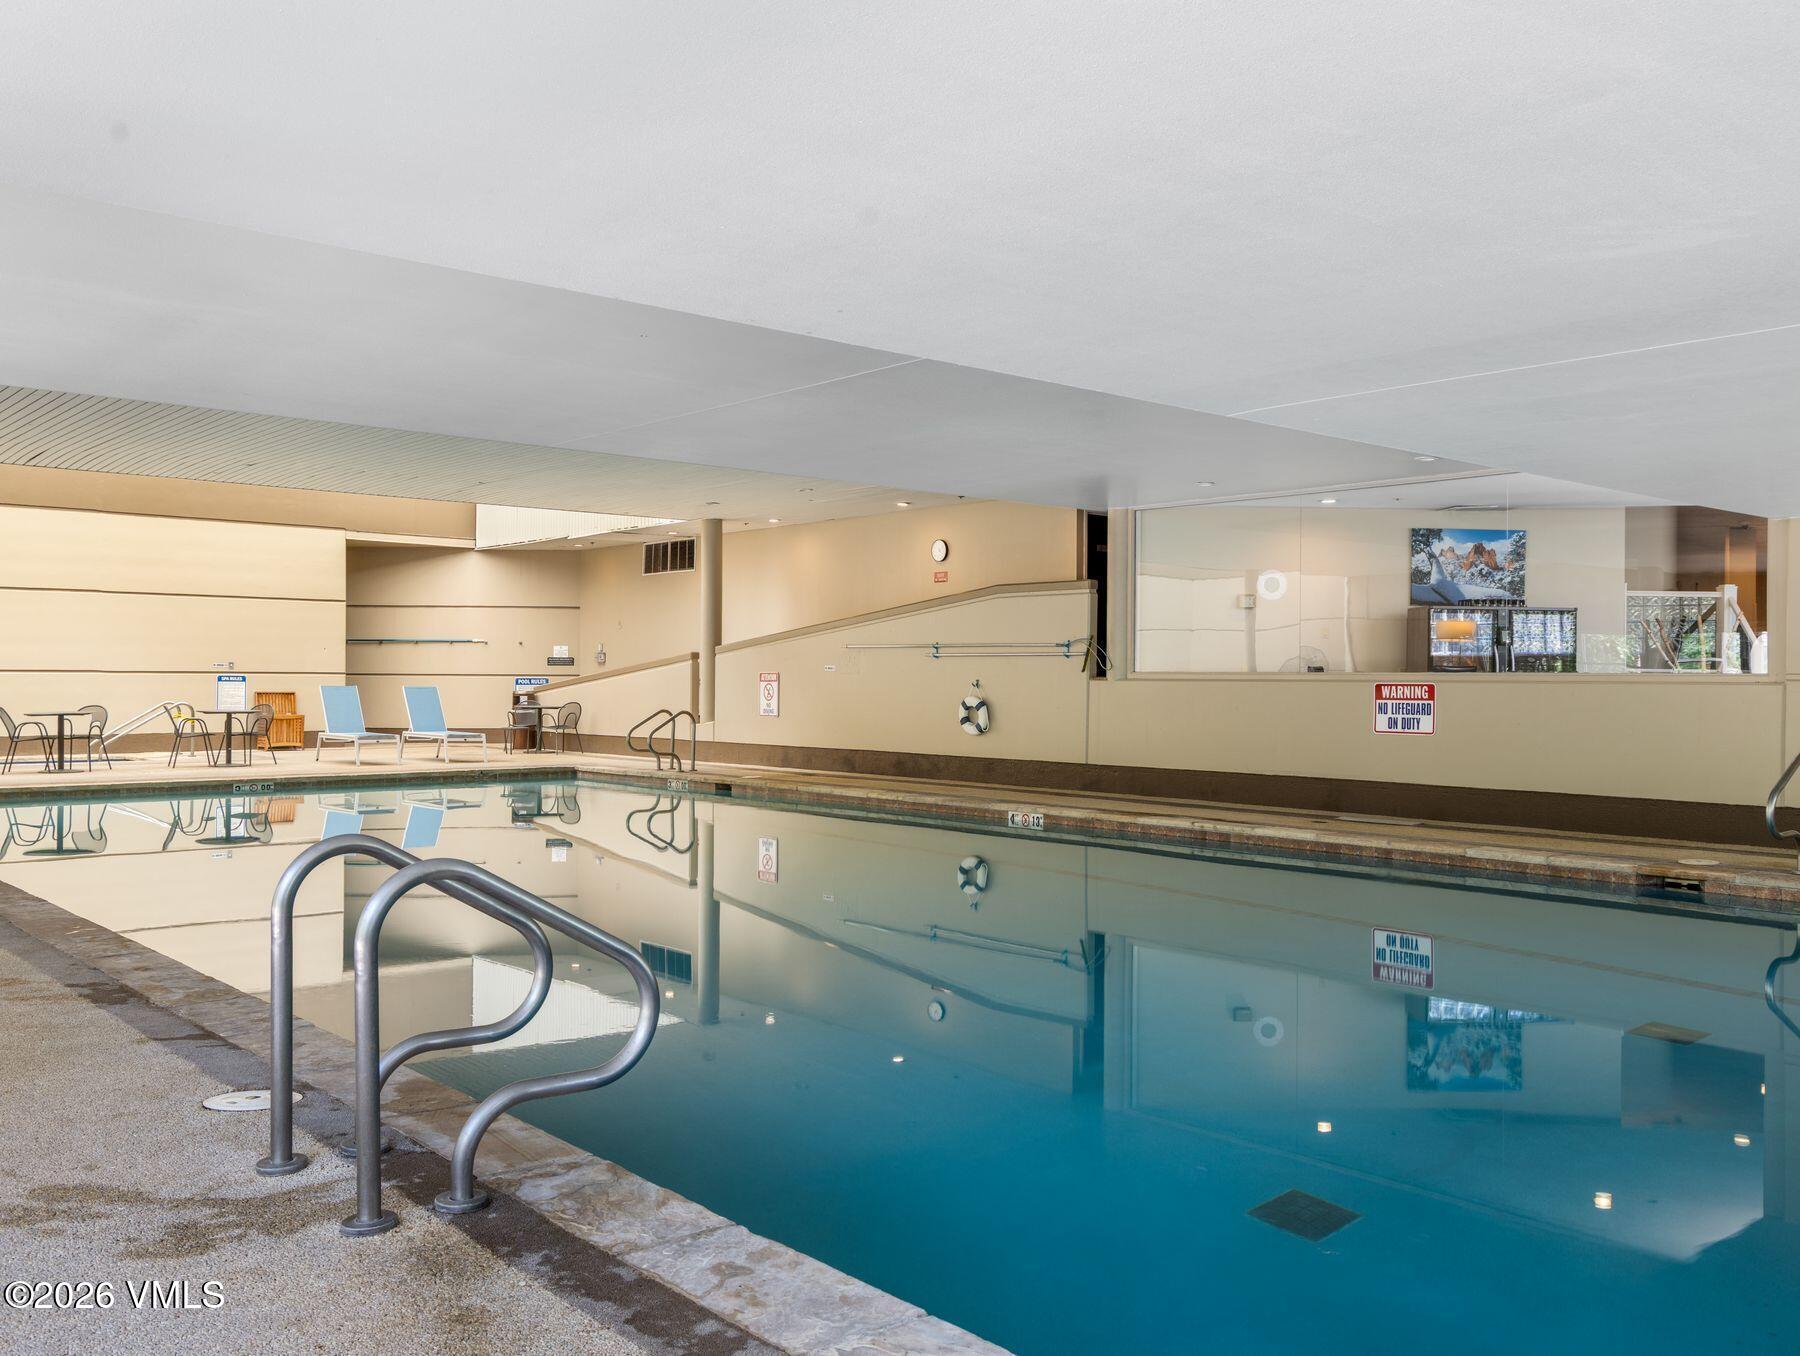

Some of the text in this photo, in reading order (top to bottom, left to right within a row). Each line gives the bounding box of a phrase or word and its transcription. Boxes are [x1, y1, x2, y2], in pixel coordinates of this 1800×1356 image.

[1381, 685, 1429, 699] WARNING
[1377, 702, 1432, 716] NO LIFEGUARD
[1387, 716, 1421, 730] ON DUTY
